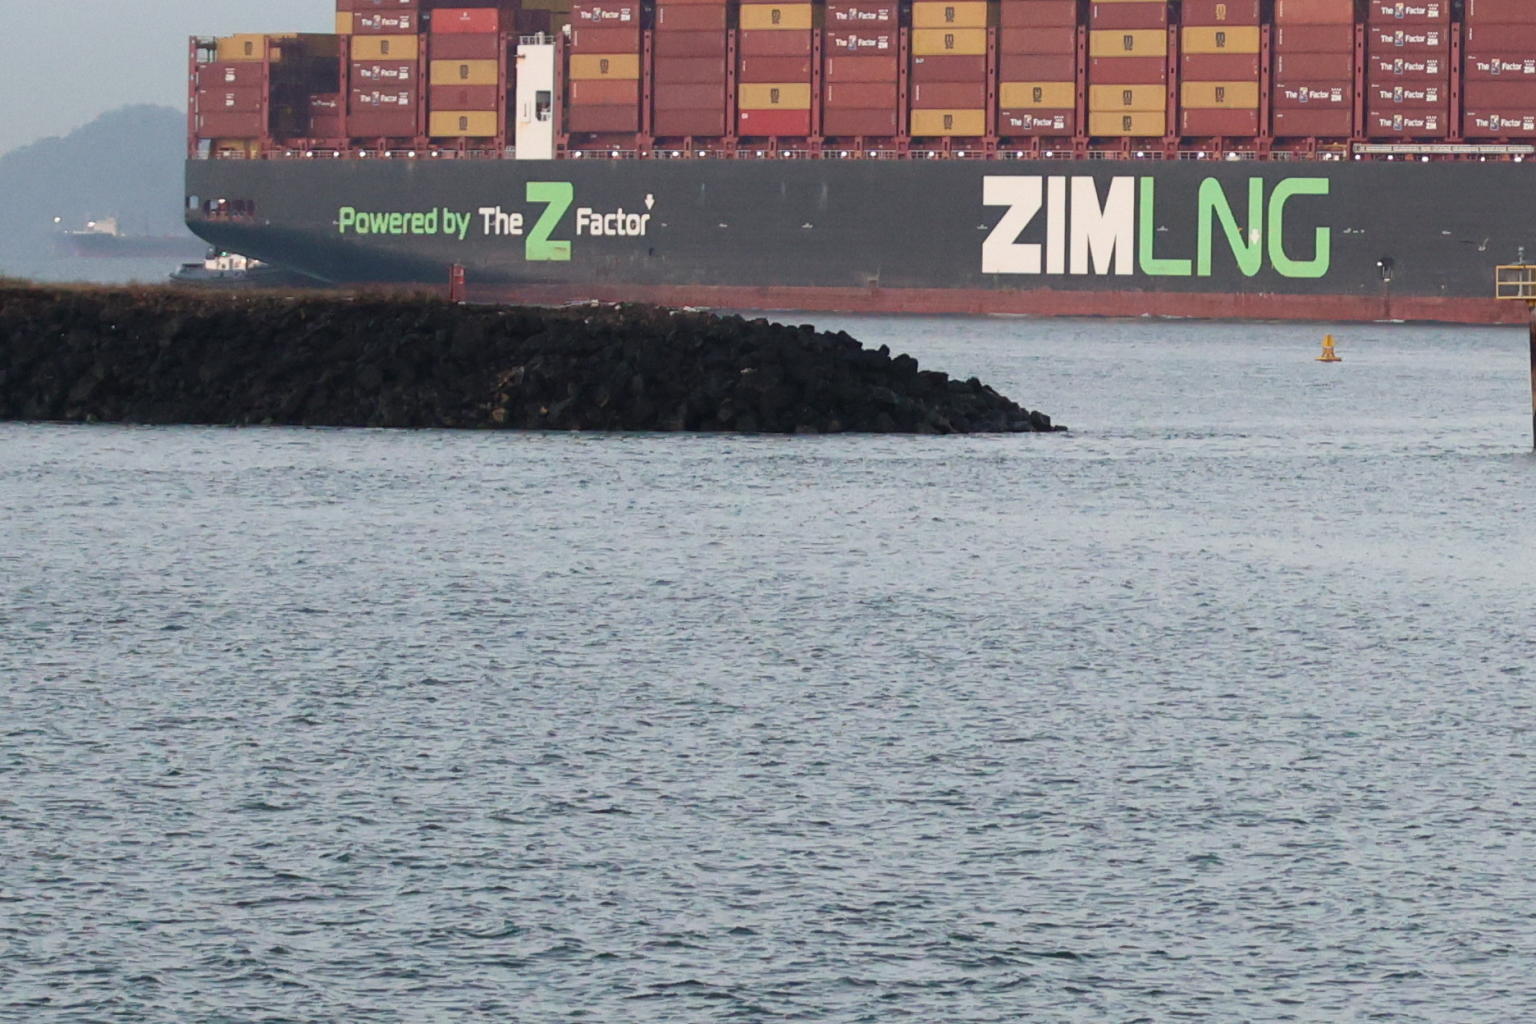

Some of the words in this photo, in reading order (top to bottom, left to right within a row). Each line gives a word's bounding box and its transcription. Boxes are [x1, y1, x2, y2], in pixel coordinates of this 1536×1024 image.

[339, 207, 438, 235] Powered
[444, 208, 471, 241] by
[479, 206, 523, 236] The
[525, 181, 574, 261] Z
[576, 208, 651, 236] Factor
